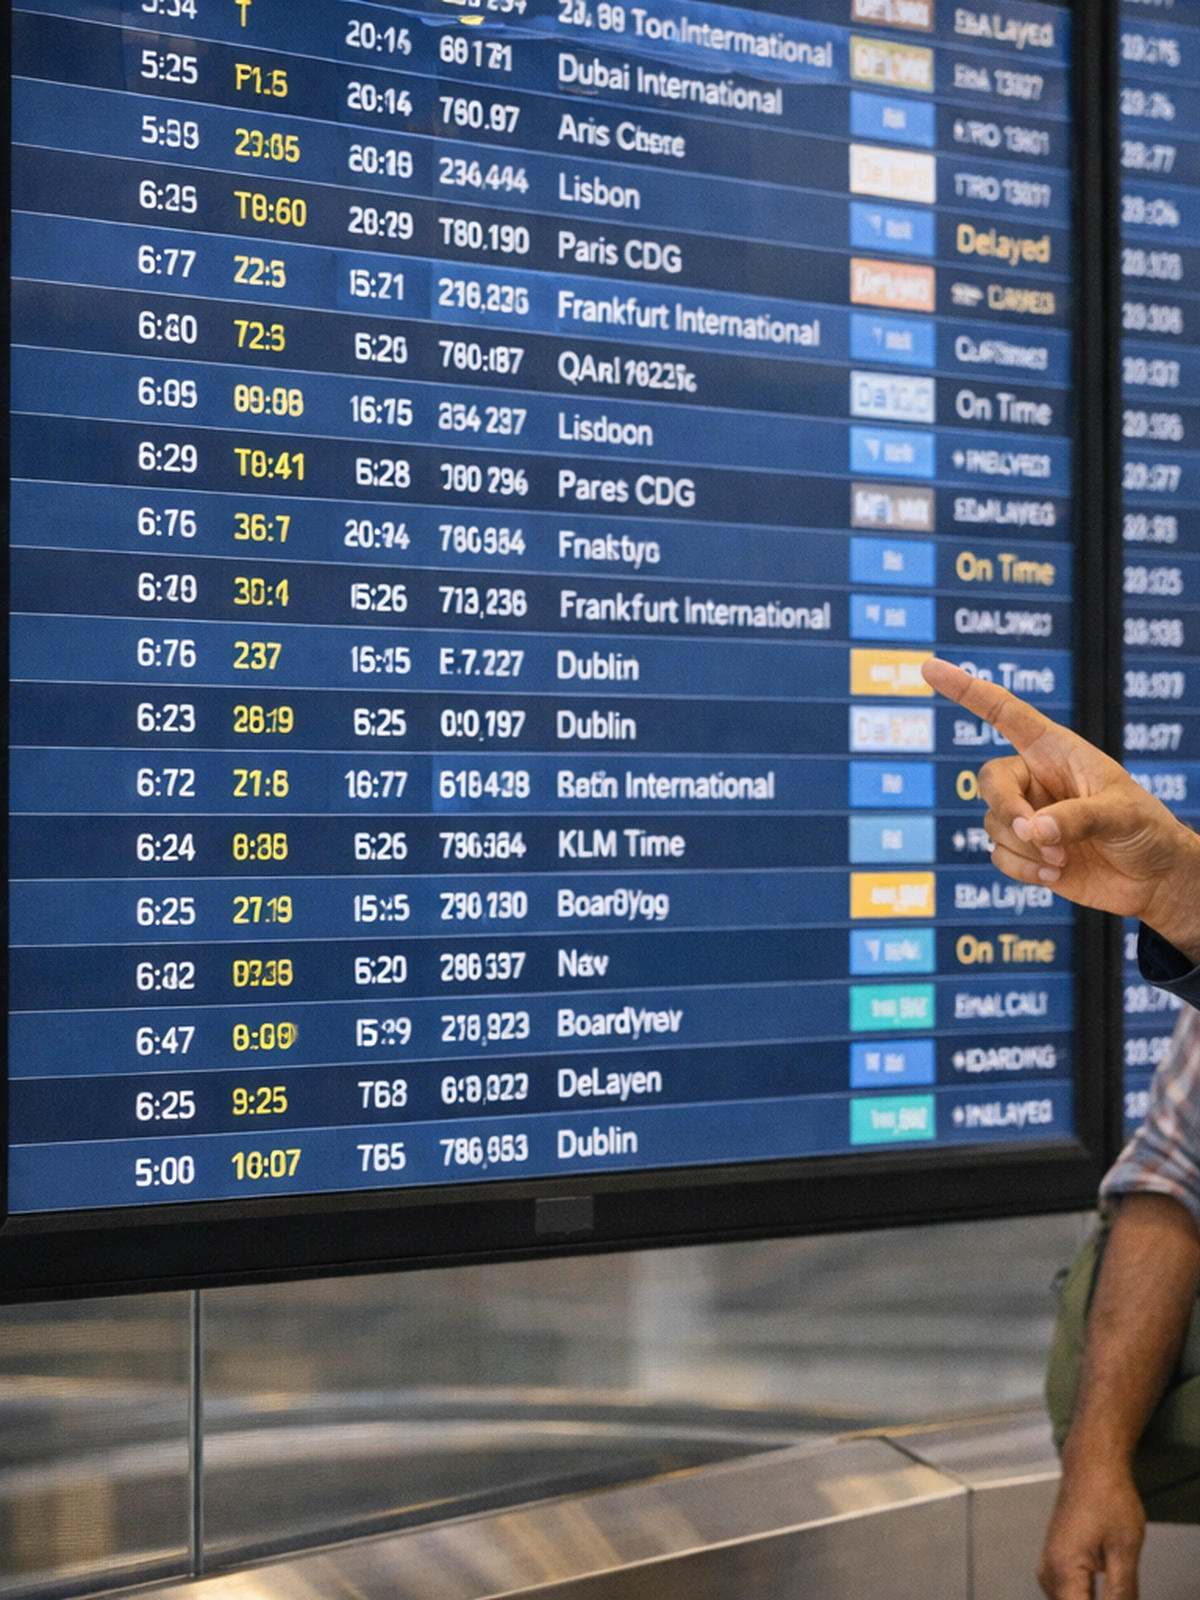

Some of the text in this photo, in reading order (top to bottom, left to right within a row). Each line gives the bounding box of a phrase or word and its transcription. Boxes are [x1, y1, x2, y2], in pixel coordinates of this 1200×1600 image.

[559, 53, 629, 90] Dubai
[638, 67, 782, 115] International
[559, 173, 640, 209] Lisbon
[957, 224, 1050, 265] Delayed
[559, 231, 618, 265] Paris
[625, 240, 682, 273] CDG
[139, 245, 196, 277] 6:77
[558, 290, 669, 329] Frankfurt
[676, 304, 819, 346] International
[956, 390, 992, 420] On
[997, 393, 1052, 425] Time
[139, 442, 197, 472] 6:29
[636, 475, 695, 507] CDG
[138, 508, 196, 537] 6:76
[235, 513, 290, 542] 36:7
[956, 552, 993, 581] On
[998, 554, 1054, 585] Time
[561, 590, 678, 623] Frankfurt
[685, 597, 830, 629] International
[138, 638, 196, 667] 6:76
[234, 642, 281, 669] 237
[557, 650, 639, 680] Dublin
[138, 703, 195, 732] 6:23
[557, 710, 636, 739] Dublin
[137, 768, 195, 796] 6:72
[626, 772, 774, 799] International
[137, 834, 195, 861] 6:24
[559, 829, 617, 857] KLM
[624, 829, 685, 857] Time
[137, 898, 195, 925] 6:25
[956, 935, 993, 964] On
[999, 934, 1054, 962] Time
[137, 1027, 195, 1055] 6:47
[136, 1091, 195, 1120] 6:25
[358, 1080, 407, 1108] 768
[357, 1143, 405, 1171] 765
[558, 1126, 637, 1158] Dublin
